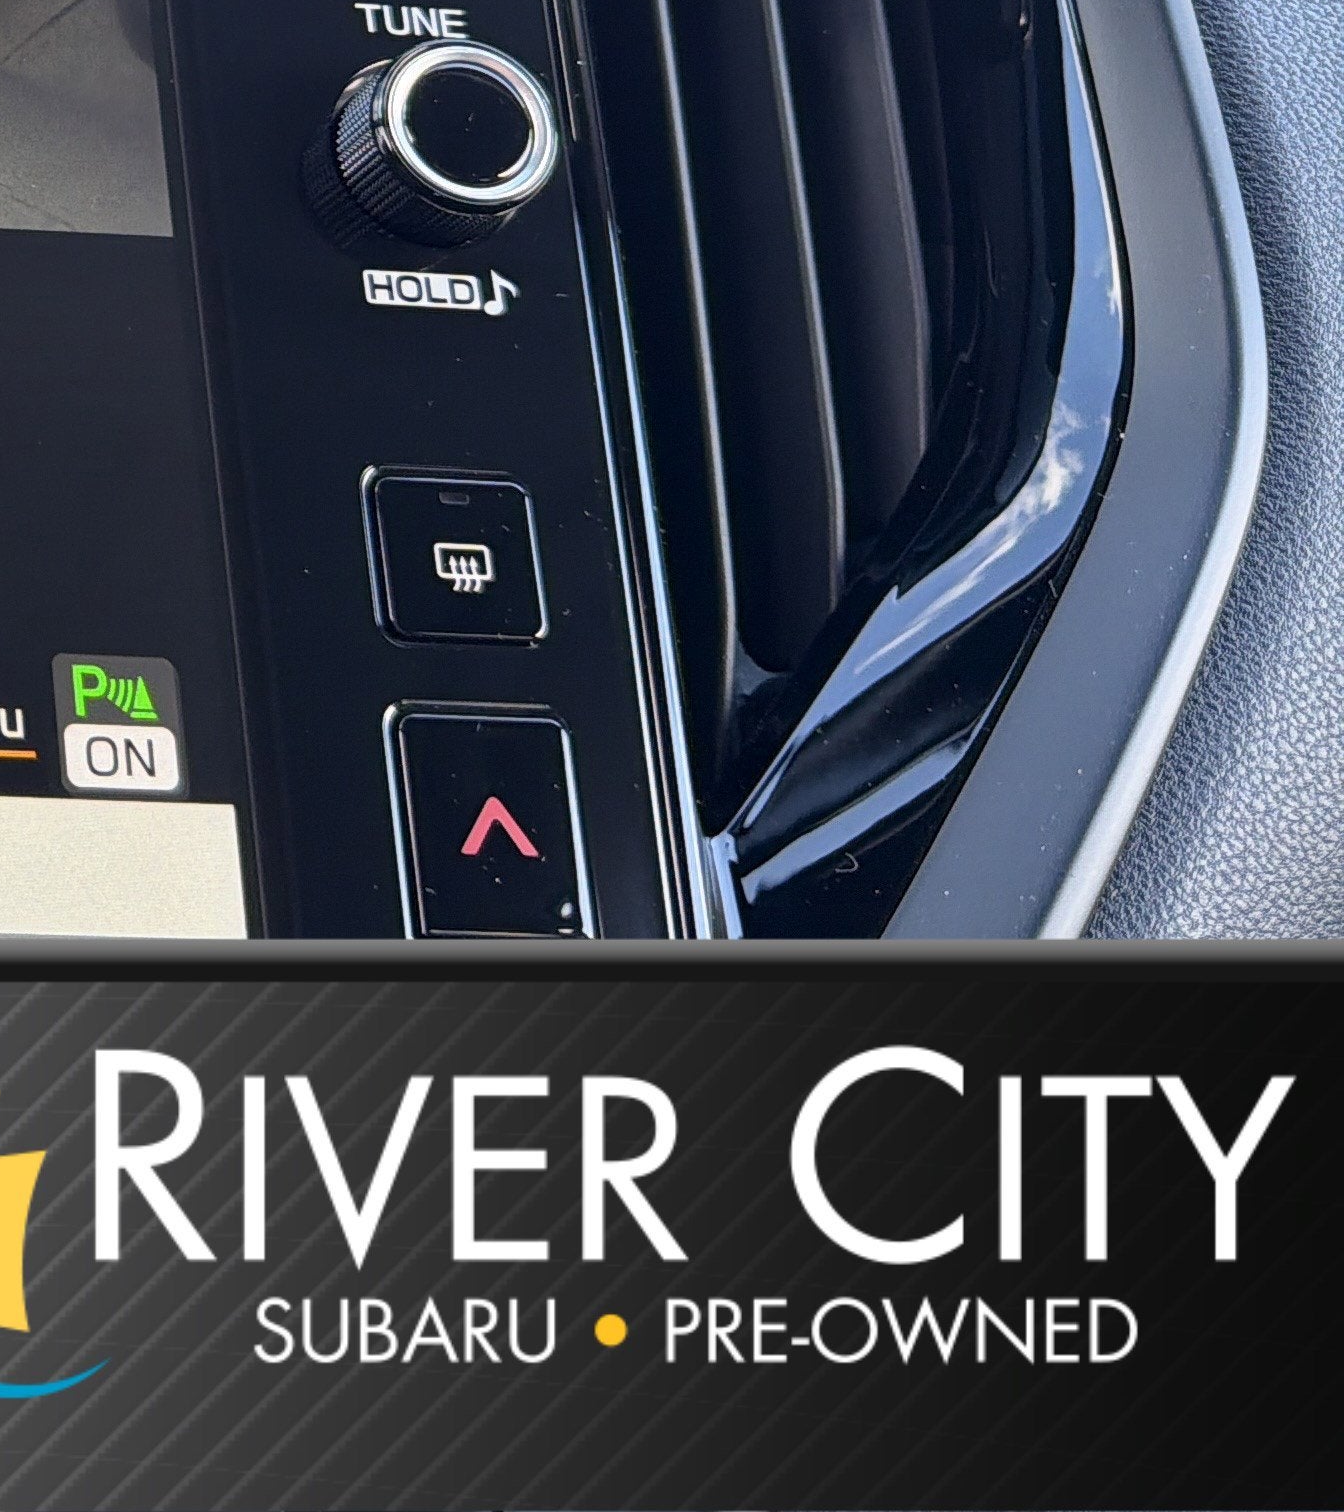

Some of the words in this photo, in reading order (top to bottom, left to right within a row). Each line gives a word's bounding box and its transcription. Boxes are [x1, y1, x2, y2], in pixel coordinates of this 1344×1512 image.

[354, 2, 467, 38] TUNE
[367, 274, 476, 306] HOLD
[85, 736, 157, 778] ON
